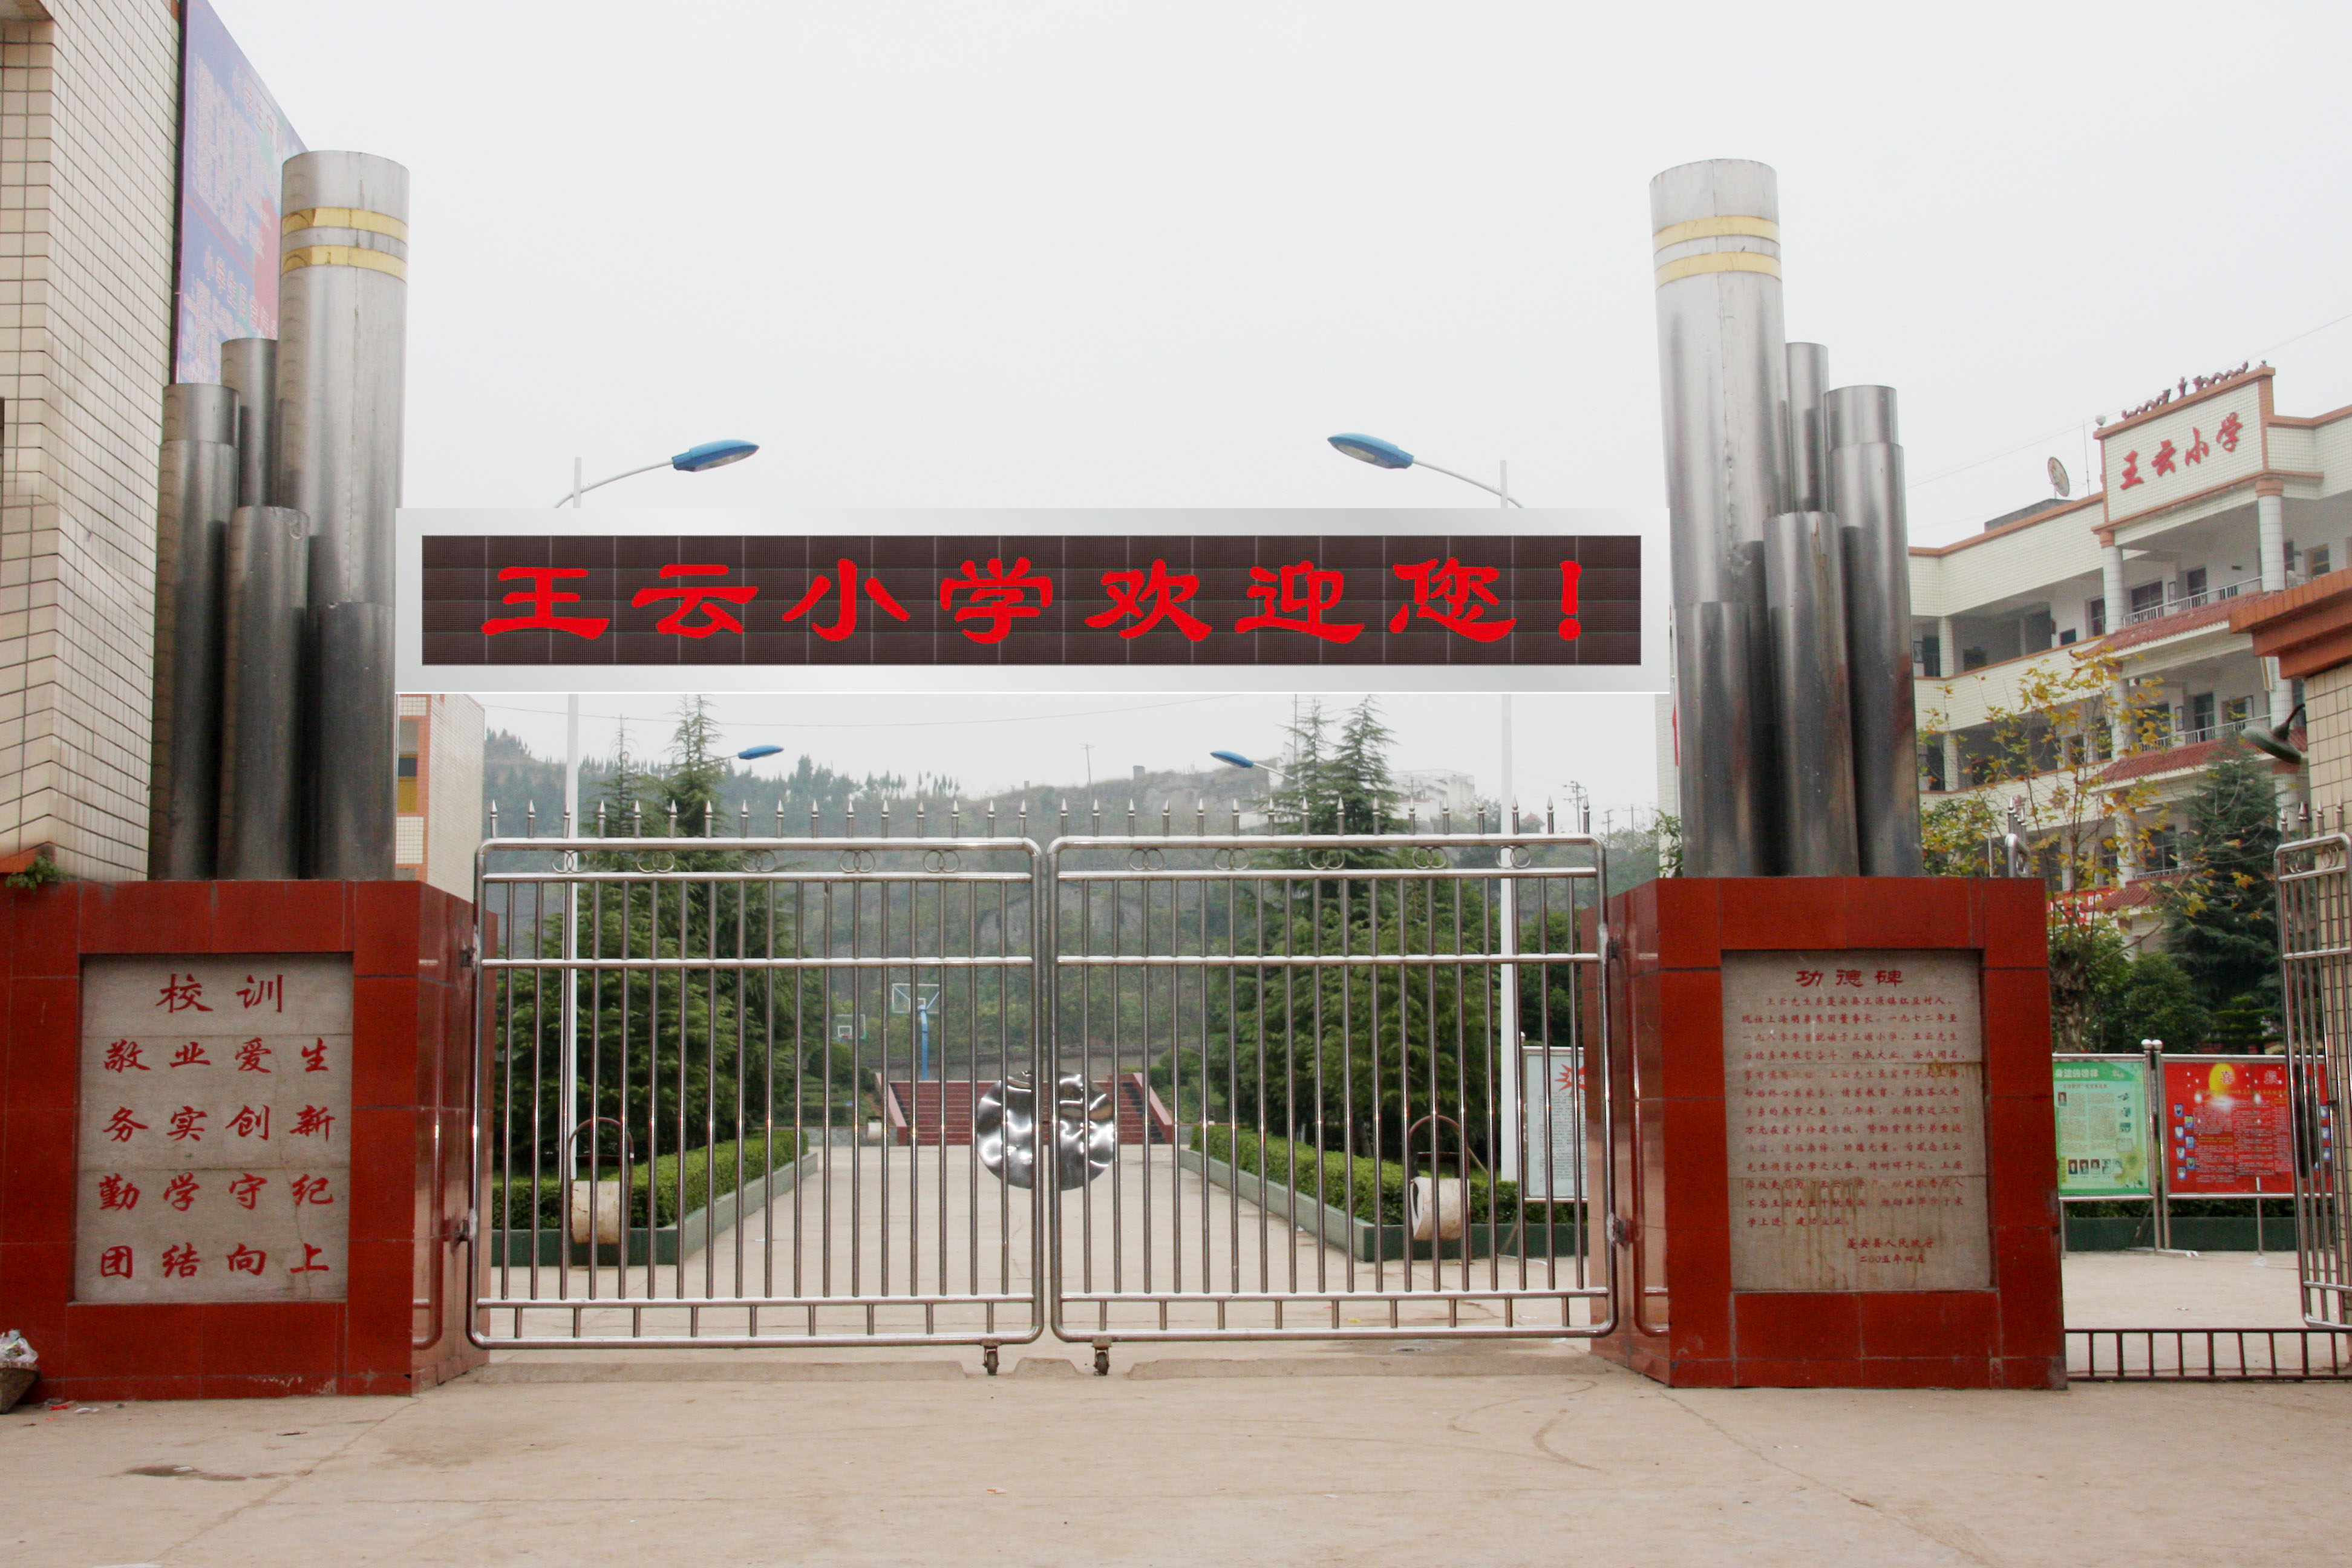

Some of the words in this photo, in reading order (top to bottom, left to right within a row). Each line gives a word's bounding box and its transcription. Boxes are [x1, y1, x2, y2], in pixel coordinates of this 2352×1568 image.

[2120, 412, 2243, 491] 王云小学
[155, 973, 284, 1014] 校训
[1794, 969, 1904, 988] 功德碑
[103, 1036, 330, 1074] 敬业爱生
[102, 1104, 336, 1143] 务实创新
[98, 1172, 335, 1212] 勤学守纪
[99, 1242, 330, 1279] 团结向上
[1846, 1236, 1934, 1250] 蓬安县人民政府
